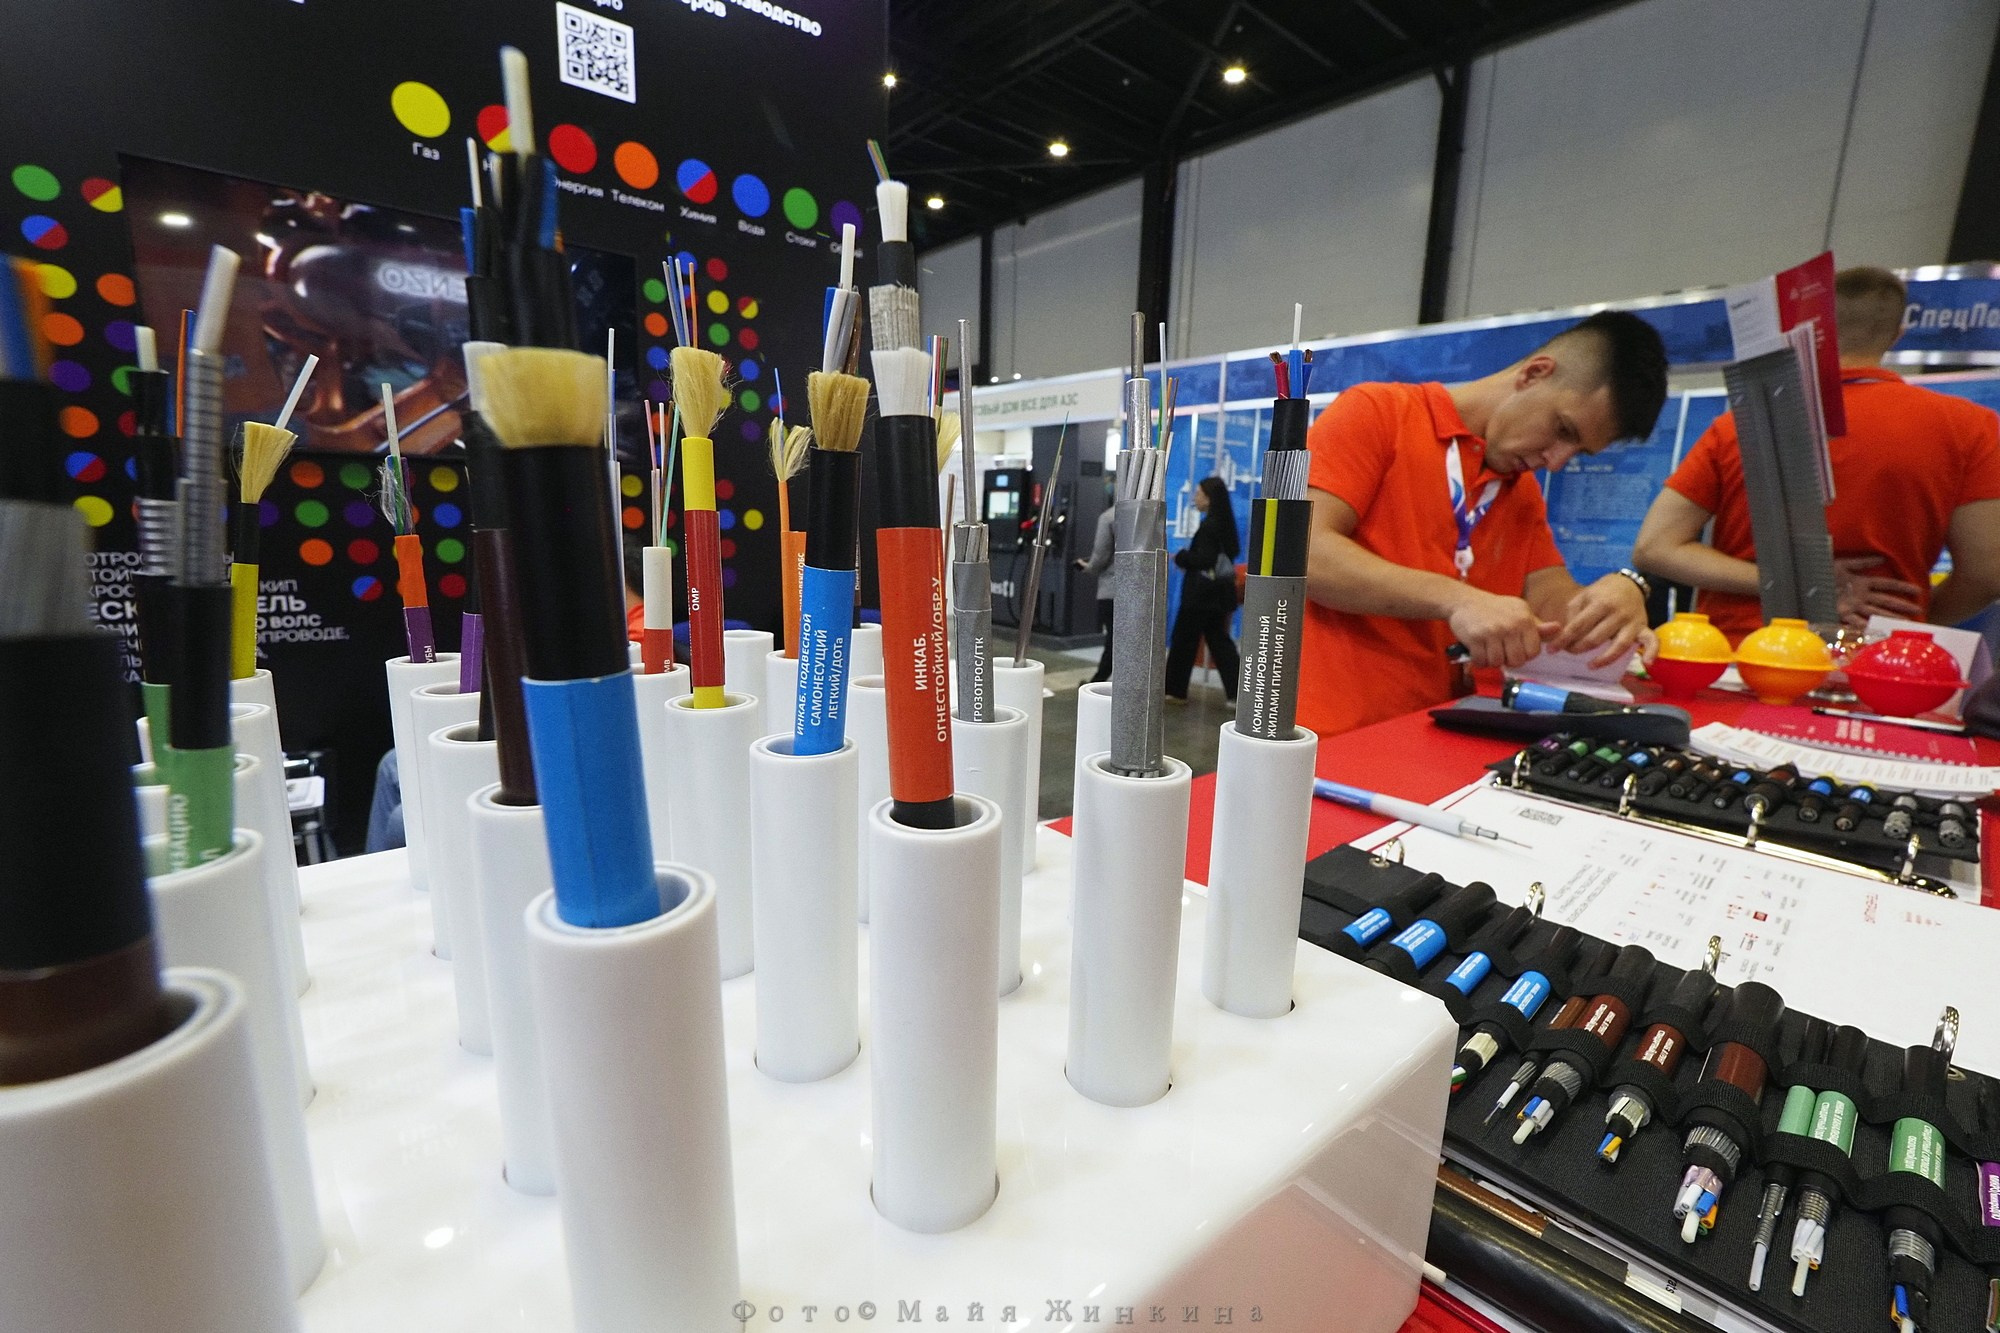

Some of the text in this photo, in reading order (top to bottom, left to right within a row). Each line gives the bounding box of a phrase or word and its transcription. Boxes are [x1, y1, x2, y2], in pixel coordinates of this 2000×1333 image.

[412, 141, 440, 161] Газ
[611, 188, 665, 212] Телеком
[679, 205, 717, 225] Химия
[737, 219, 766, 237] Вода
[785, 230, 817, 248] Стоки
[691, 587, 700, 611] ОМР
[1276, 599, 1288, 625] ДПС
[269, 613, 322, 629] ВОЛС
[796, 613, 812, 736] ИНКАБ. ПОДВЕСНОЙ
[810, 629, 829, 727] САМОНЕСУЩИЙ
[828, 637, 844, 719] ЛЕГКИЙ/ДОТа
[913, 633, 928, 691] ИНКАБ.
[931, 577, 947, 742] ОГНЕСТОЙКИЙ/ОБР-У
[1243, 653, 1253, 693] ИНКАБ.
[1252, 614, 1271, 733] КОМБИНИРОВАННЫЙ
[1271, 633, 1285, 687] ПИТАНИЯ
[1267, 688, 1281, 738] ЖИЛАМИ
